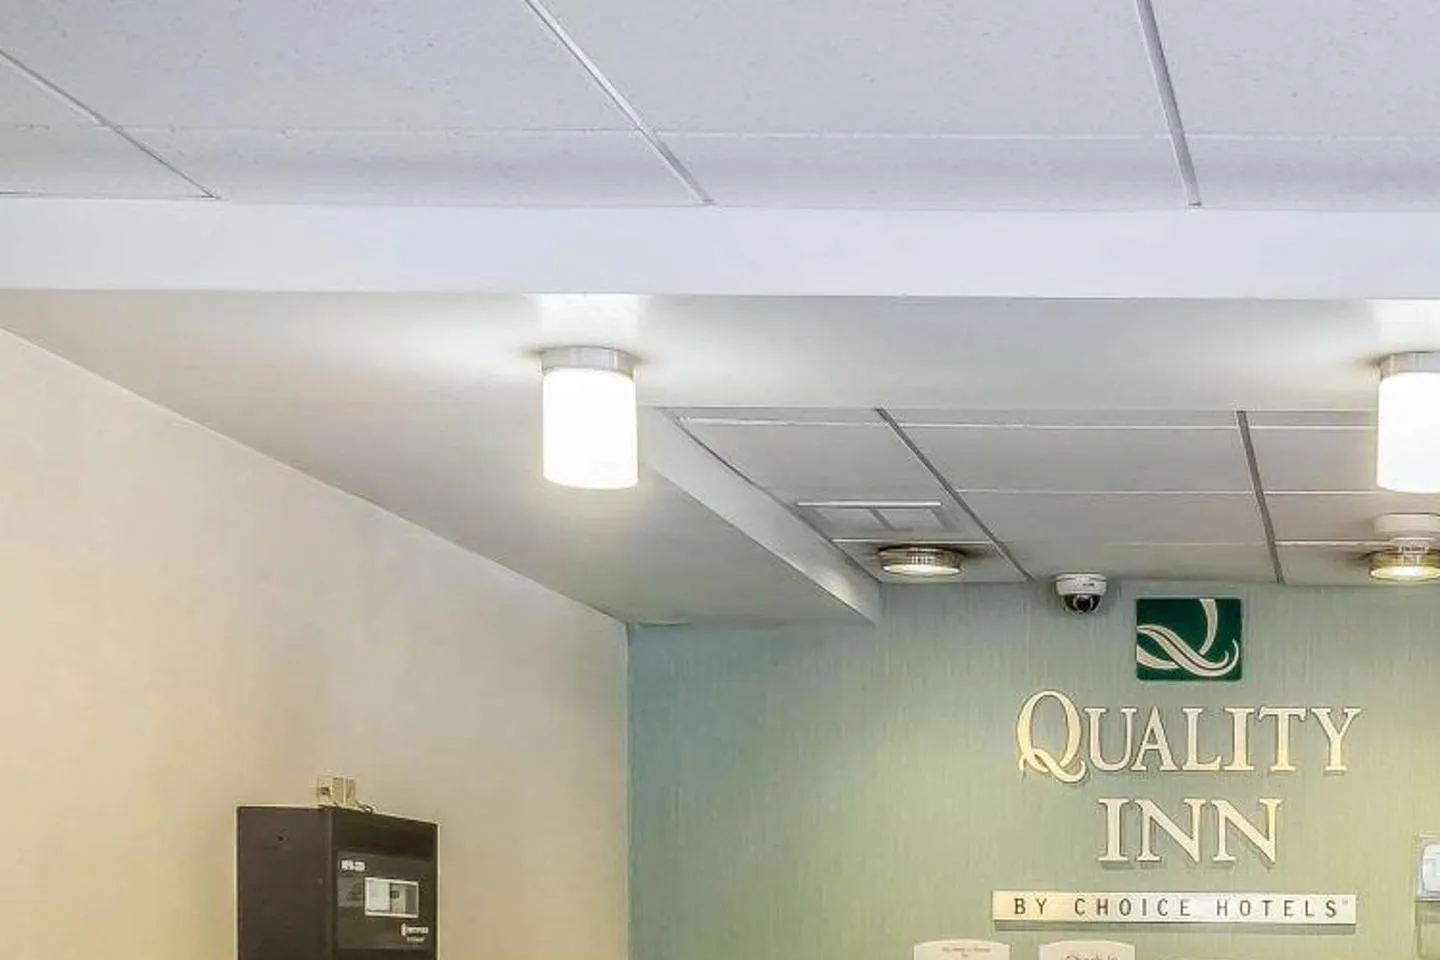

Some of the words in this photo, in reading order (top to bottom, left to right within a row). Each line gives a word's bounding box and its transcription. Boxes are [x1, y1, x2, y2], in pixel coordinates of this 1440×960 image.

[1016, 690, 1362, 783] QUALITY
[1098, 798, 1283, 864] INN
[1014, 897, 1049, 916] BY
[1074, 897, 1192, 918] CHOICE
[1217, 899, 1338, 919] HOTELS
